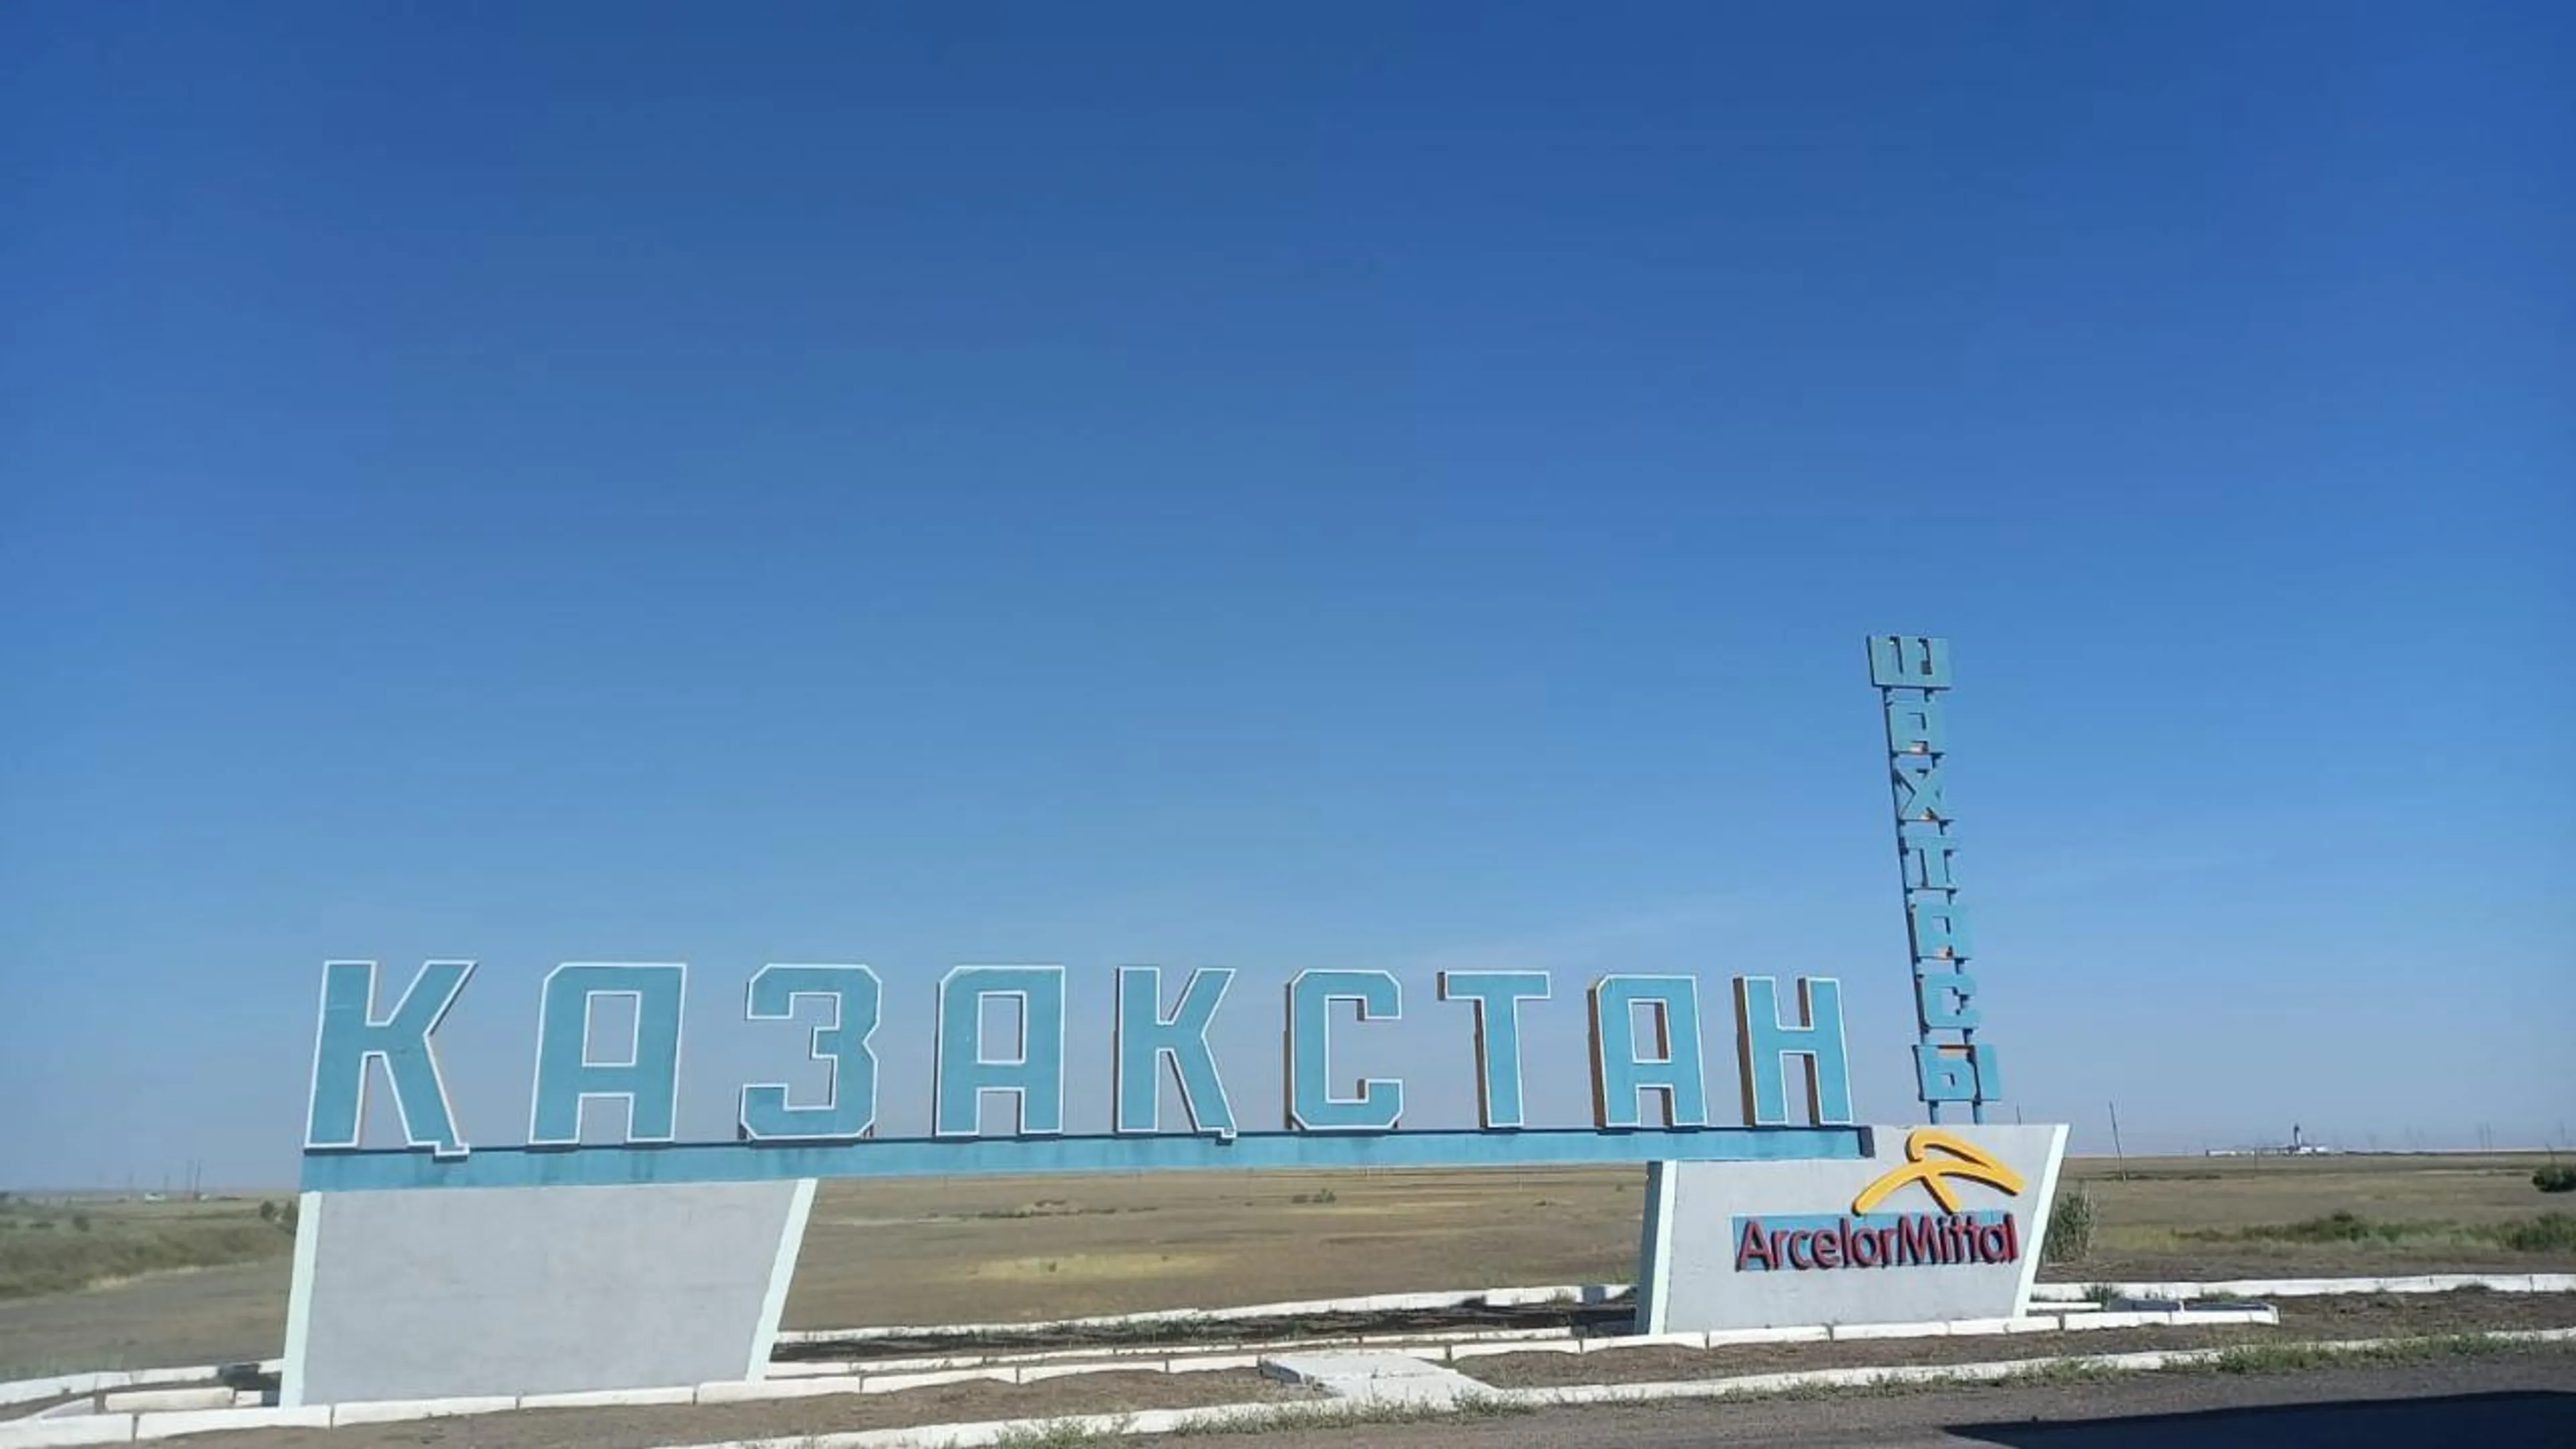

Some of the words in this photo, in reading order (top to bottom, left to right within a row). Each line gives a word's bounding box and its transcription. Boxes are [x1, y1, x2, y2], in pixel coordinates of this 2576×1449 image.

[1867, 635, 2001, 1102] ШАХТАСЫ
[304, 959, 1854, 1159] ҚАЗАҚСТАН
[1735, 1212, 2019, 1272] ArcelorMittal
